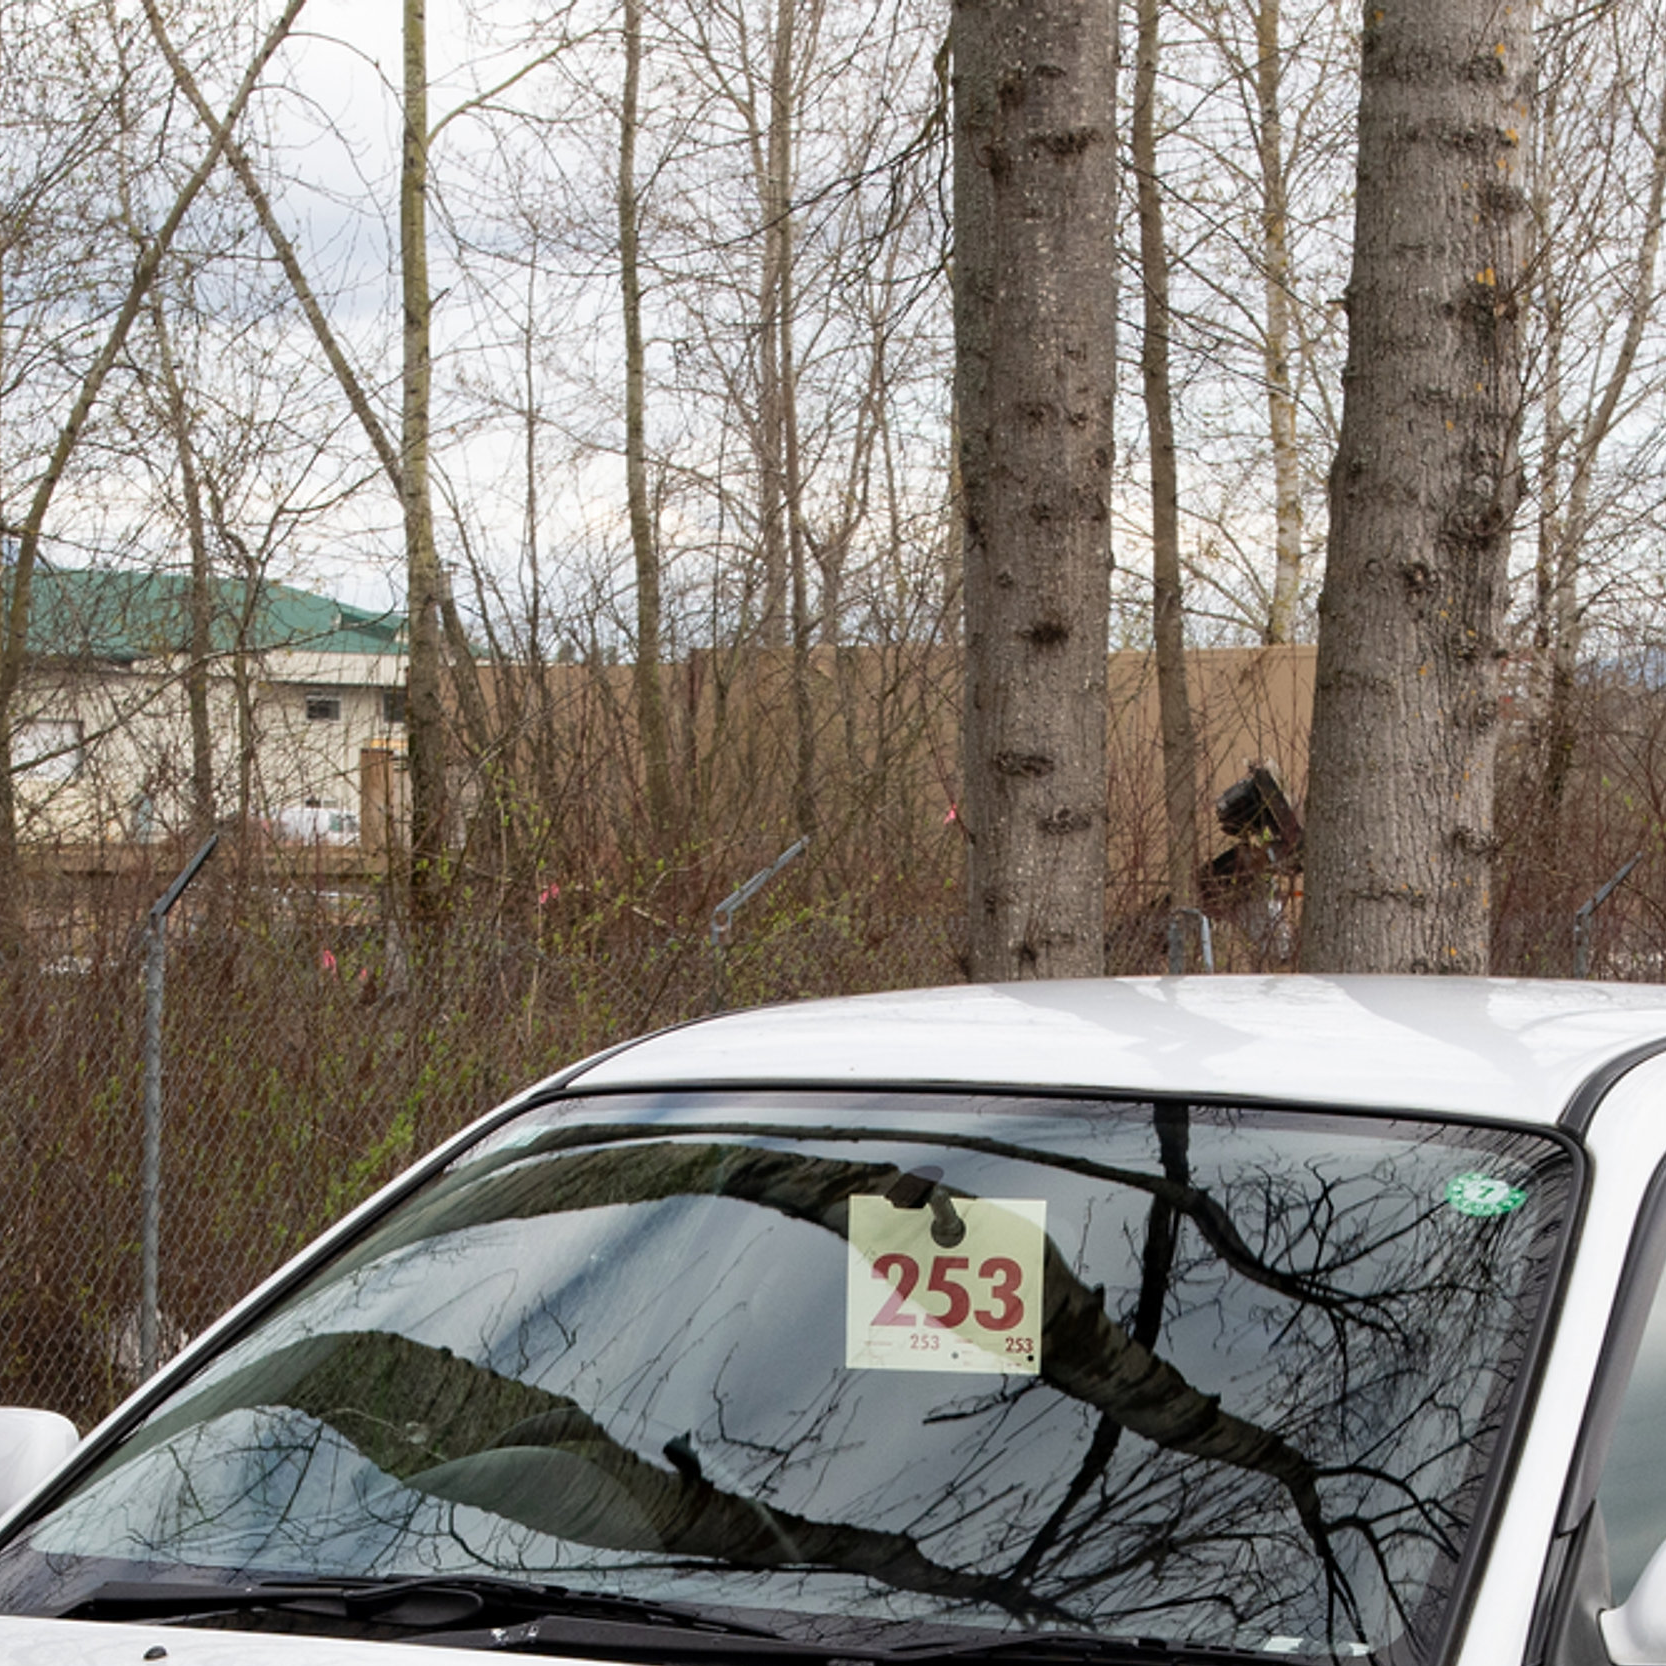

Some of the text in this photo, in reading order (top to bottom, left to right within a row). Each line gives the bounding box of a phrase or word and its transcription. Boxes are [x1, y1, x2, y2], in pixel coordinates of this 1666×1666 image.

[870, 1253, 1025, 1331] 253
[910, 1334, 940, 1350] 253
[1005, 1337, 1034, 1353] 253
